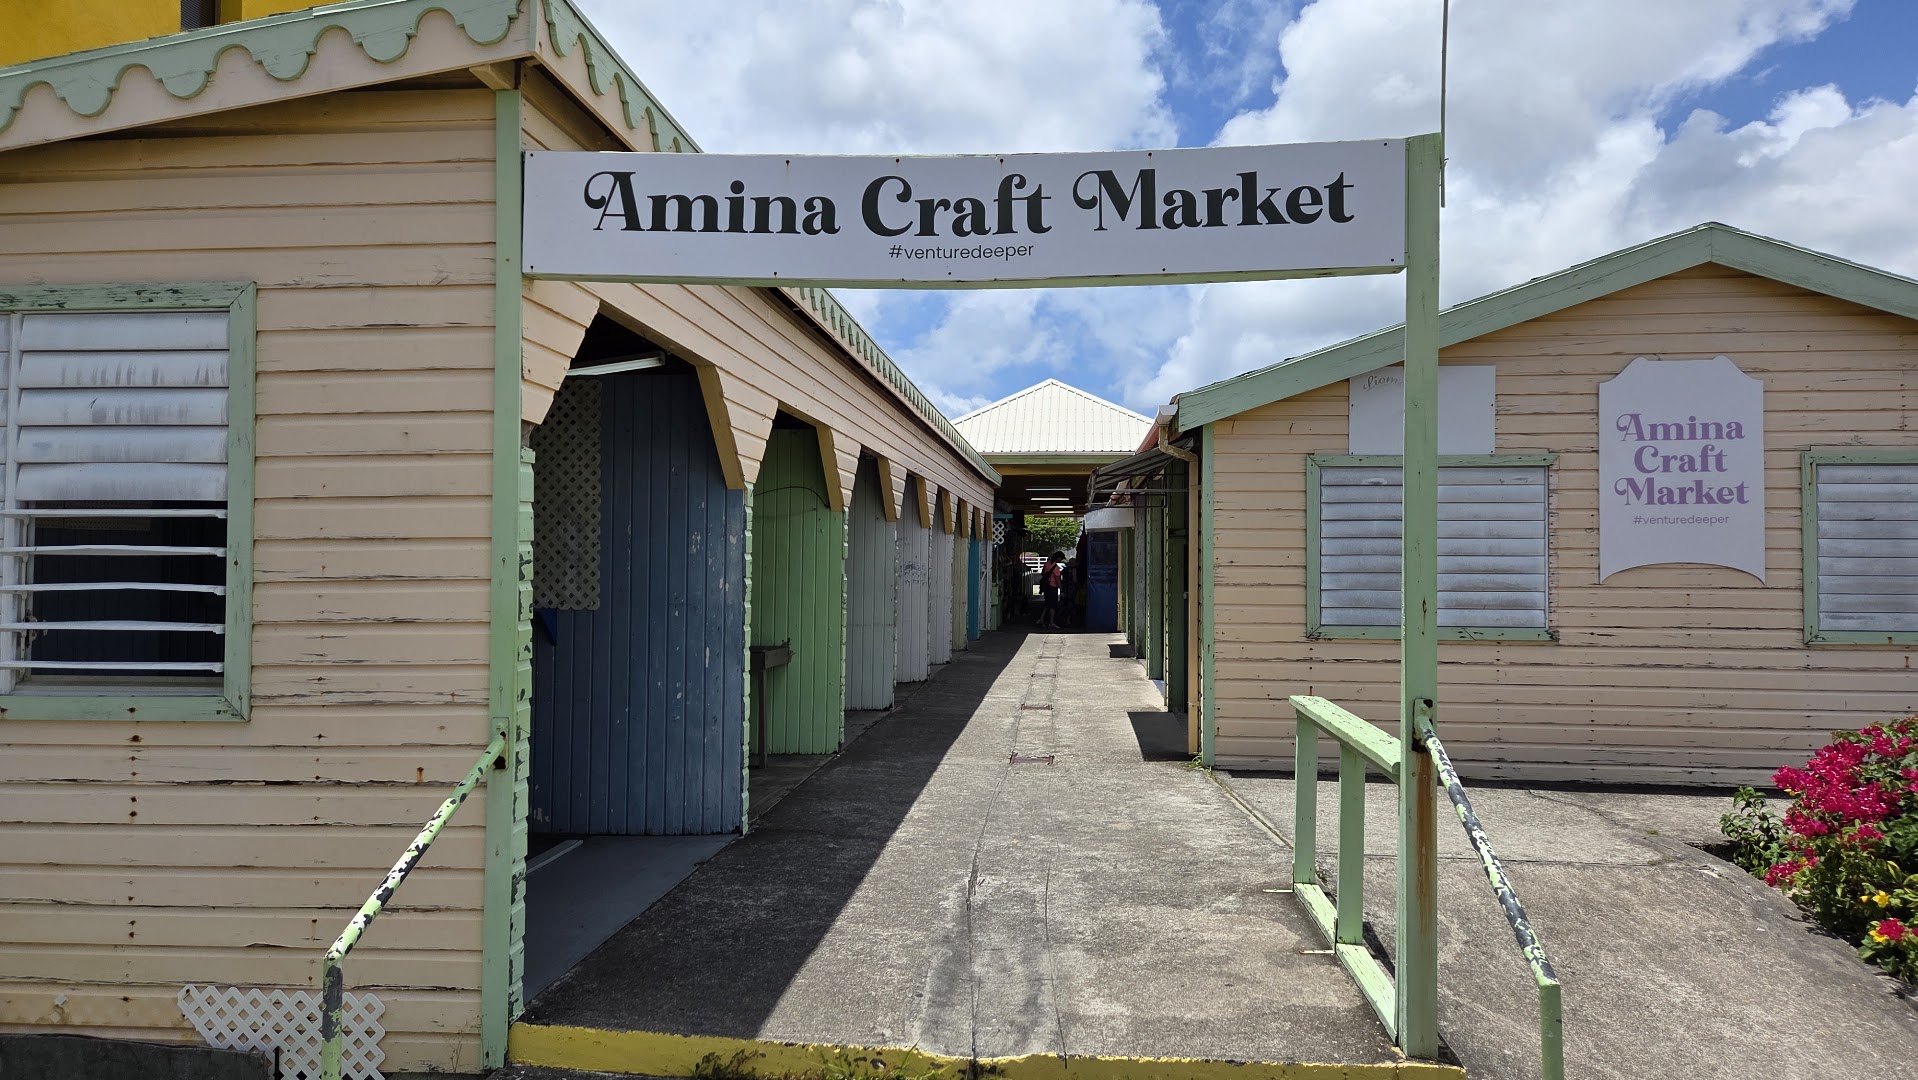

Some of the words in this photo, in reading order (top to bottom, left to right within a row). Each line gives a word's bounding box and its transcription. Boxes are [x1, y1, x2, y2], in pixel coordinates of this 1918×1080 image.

[584, 171, 841, 236] Amina
[862, 174, 1053, 238] Craft
[1073, 168, 1355, 231] Market
[889, 244, 1034, 261] #venturedeeper
[1616, 413, 1746, 442] Amina
[1633, 443, 1728, 474] Craft
[1614, 477, 1750, 506] Market
[1633, 514, 1730, 527] #venturedeeper
